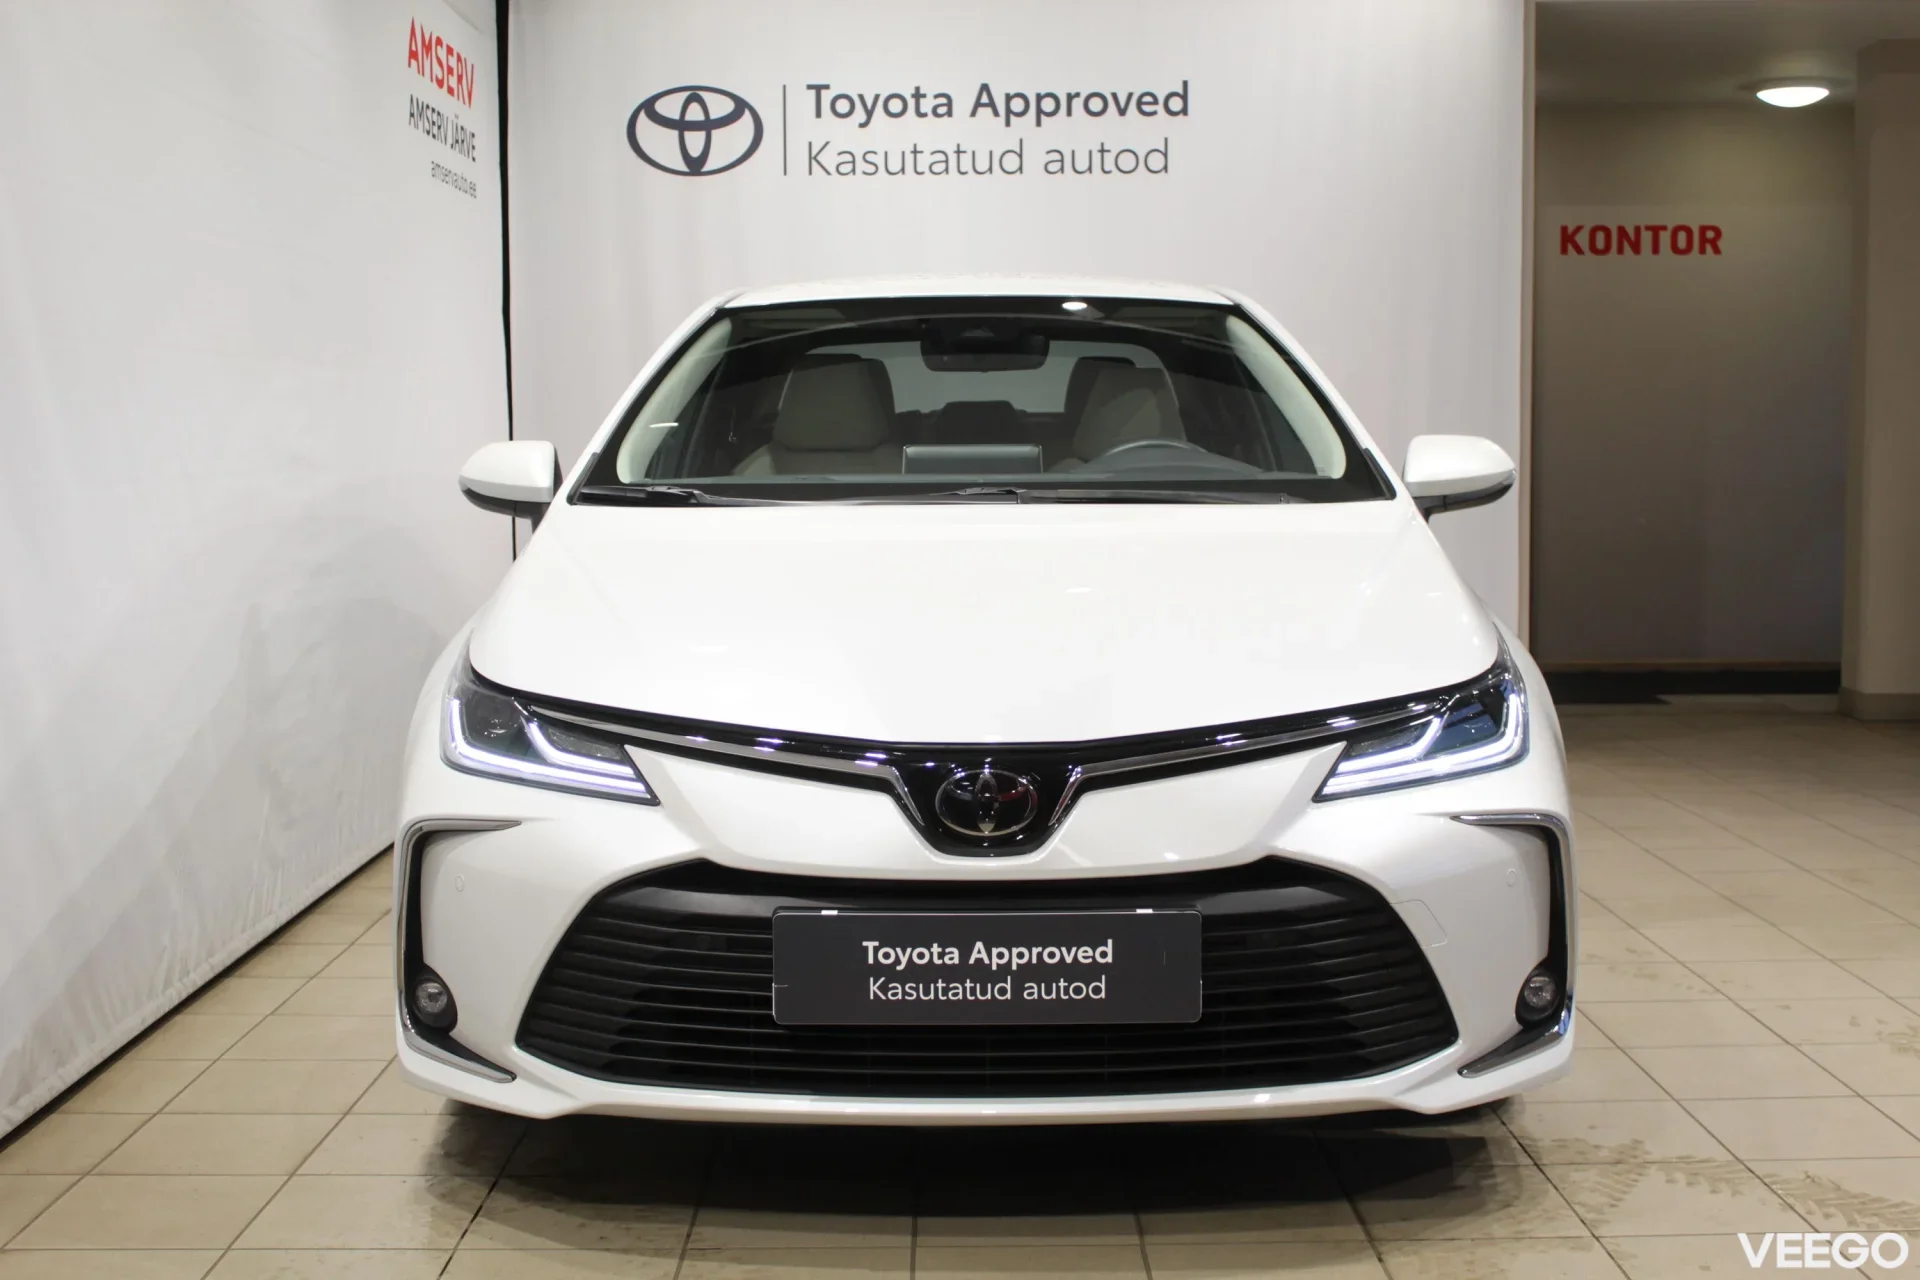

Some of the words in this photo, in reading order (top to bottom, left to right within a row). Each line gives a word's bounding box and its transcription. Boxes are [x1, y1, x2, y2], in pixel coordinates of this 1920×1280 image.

[408, 16, 474, 109] AMSERV
[806, 83, 953, 128] Toyota
[970, 80, 1190, 128] Approved
[409, 94, 448, 146] AMSERV
[451, 113, 476, 162] JÄRVE
[807, 138, 1024, 176] Kasutatud
[1043, 137, 1169, 176] autod
[431, 160, 477, 199] amservauto.ee
[1560, 224, 1722, 256] KONTOR
[862, 940, 959, 970] Toyota
[968, 939, 1113, 970] Approved
[869, 976, 1011, 1000] Kasutatud
[1023, 975, 1106, 1000] autod
